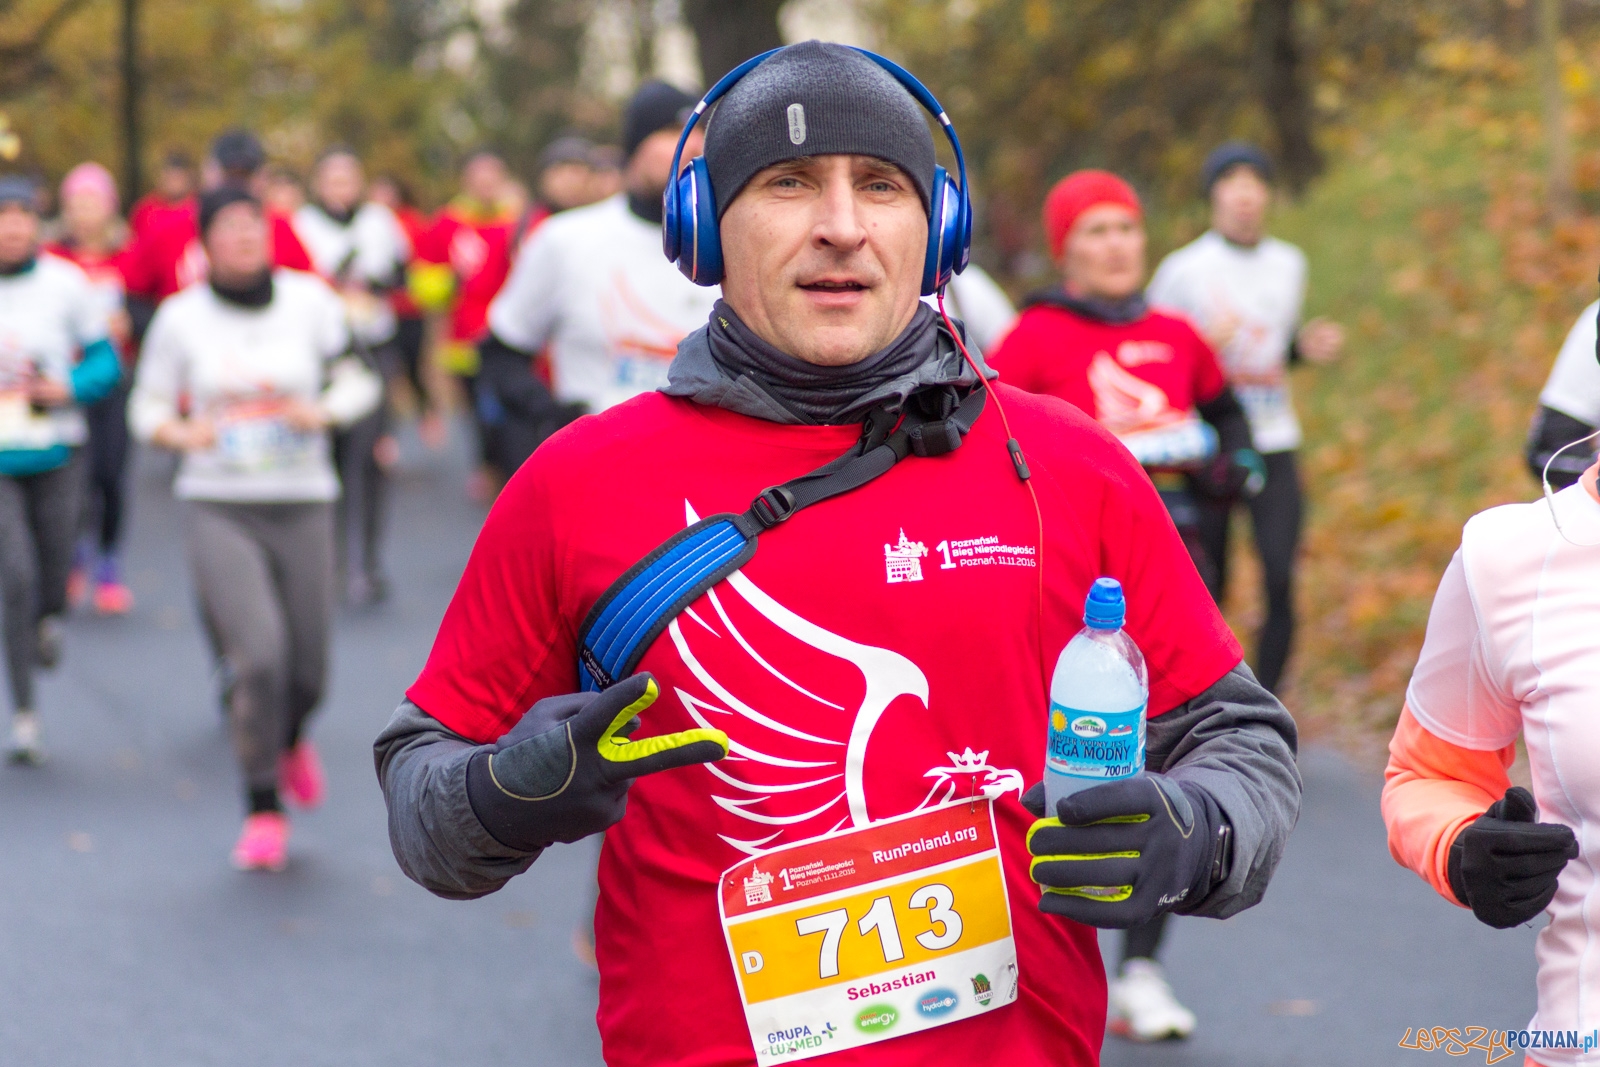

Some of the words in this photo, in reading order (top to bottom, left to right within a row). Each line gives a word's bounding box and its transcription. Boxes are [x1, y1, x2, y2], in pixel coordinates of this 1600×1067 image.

[951, 535, 999, 548] Poznański
[952, 547, 973, 557] Bieg
[974, 545, 1036, 555] Niepodległości
[936, 540, 956, 569] 1
[960, 556, 998, 567] Poznań,
[998, 556, 1036, 567] 11.11.2016
[1049, 737, 1080, 758] MEGA
[1083, 745, 1131, 761] MODNY
[1110, 739, 1127, 748] JEST
[1104, 765, 1121, 777] 700
[1121, 762, 1132, 775] ml
[872, 826, 978, 864] RunPoland.org
[789, 860, 824, 874] Poznański
[790, 871, 806, 881] Bieg
[805, 859, 855, 877] Niepodległości
[796, 876, 824, 887] Poznań,
[823, 868, 856, 882] 11.11.2016
[779, 868, 795, 891] 1
[795, 883, 964, 979] 713
[740, 950, 765, 975] D
[846, 970, 937, 1001] Sebastian
[861, 1013, 895, 1027] energy
[767, 1024, 812, 1044] GRUPA
[770, 1034, 823, 1056] LUXMED
